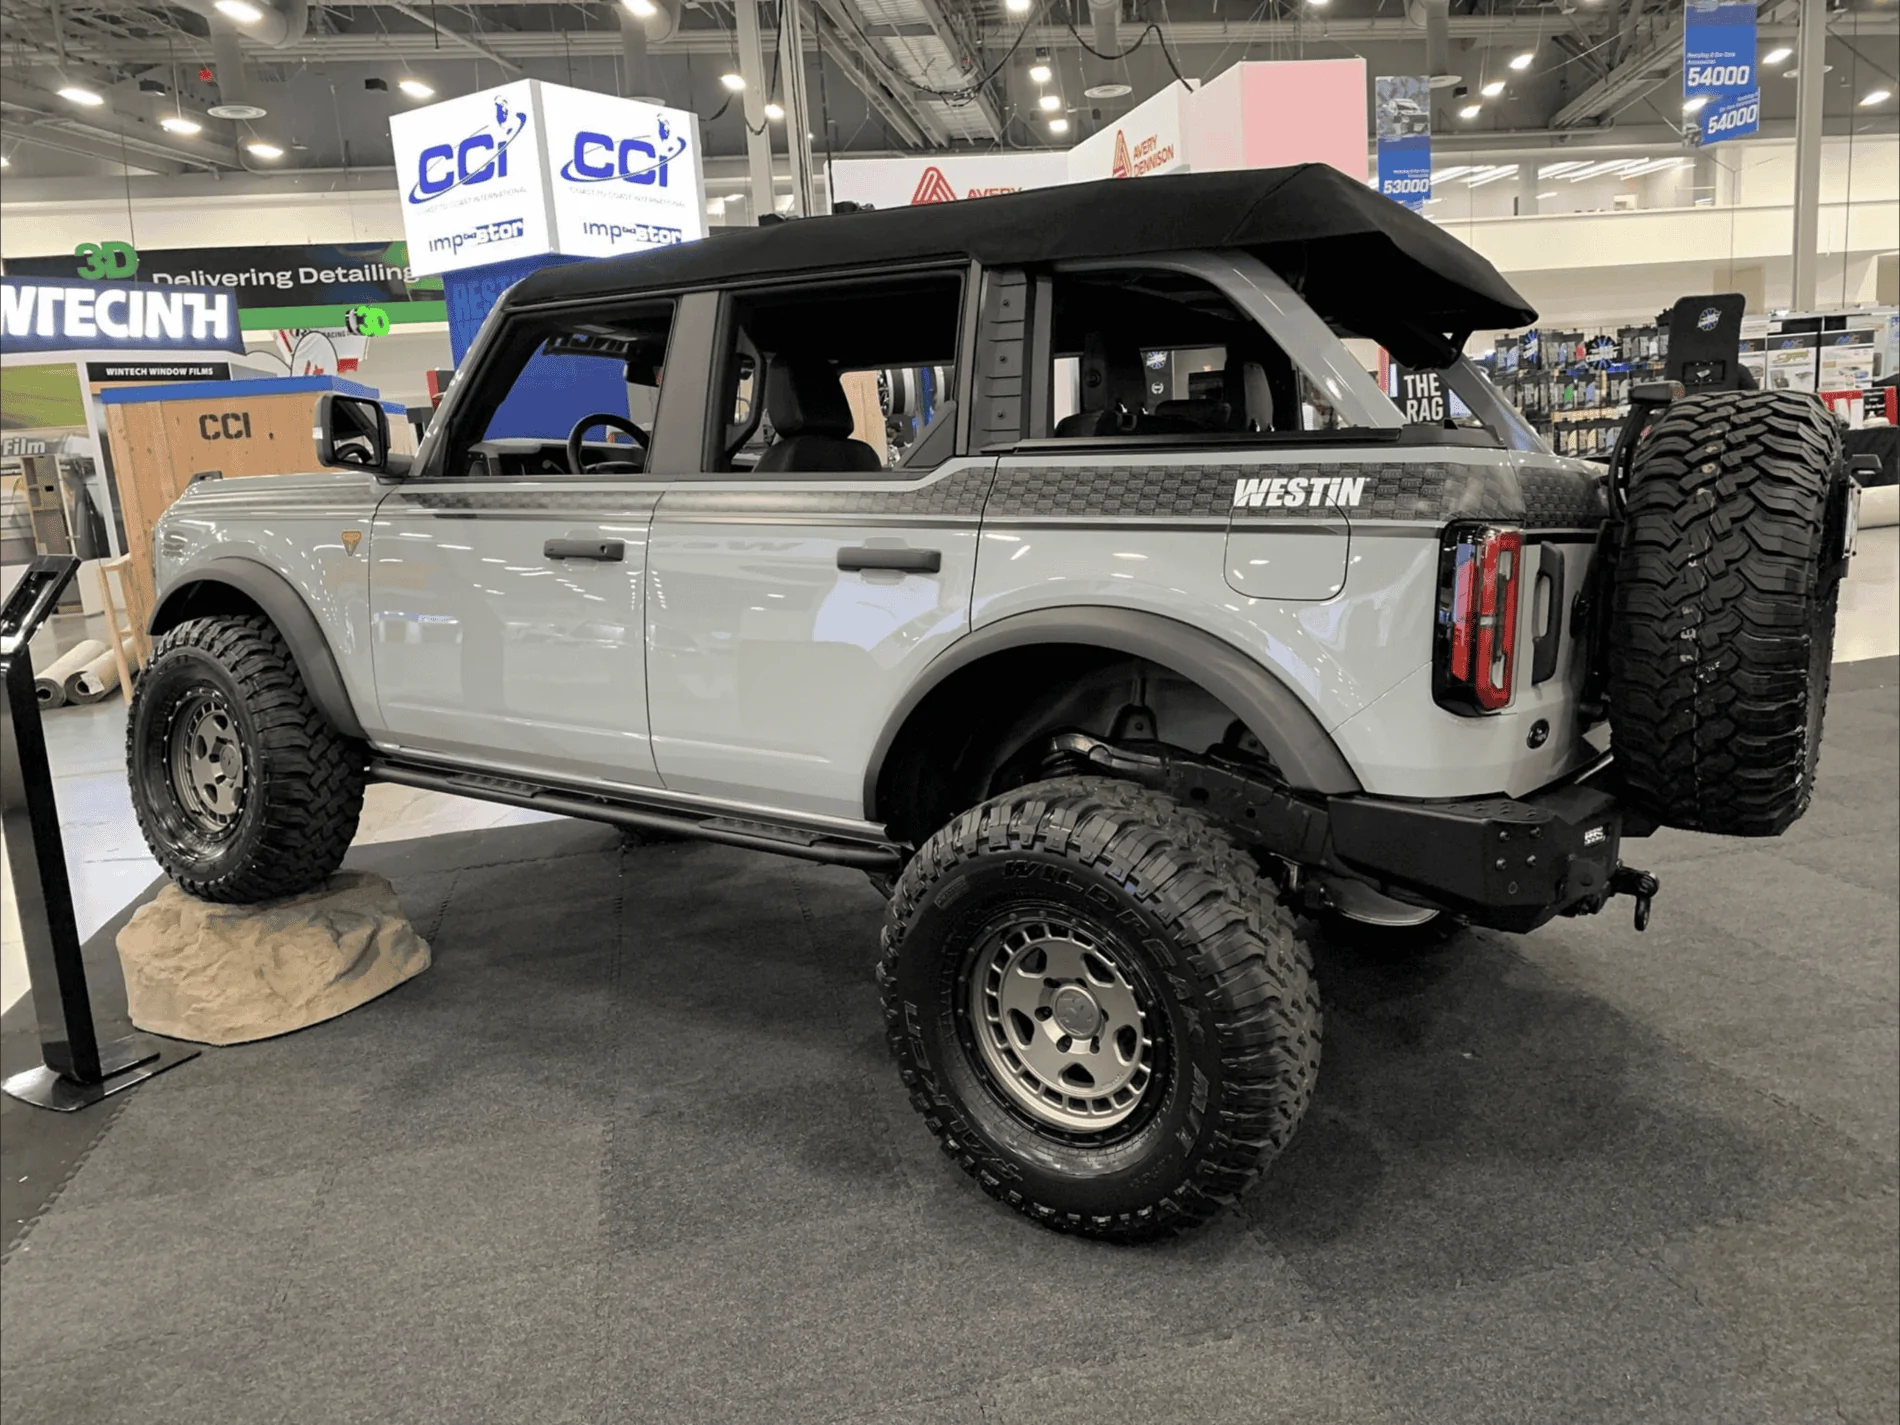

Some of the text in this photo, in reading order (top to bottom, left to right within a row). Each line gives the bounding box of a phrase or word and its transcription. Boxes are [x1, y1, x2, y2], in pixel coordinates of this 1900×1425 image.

[1687, 65, 1750, 87] 54000
[1707, 104, 1758, 134] 54000
[1134, 133, 1158, 160] AVERY
[1383, 179, 1429, 194] 53000
[75, 241, 139, 280] 3D
[152, 264, 420, 290] Delivering Detailing
[105, 367, 214, 376] WINTECH WINDOW FILMS
[1403, 372, 1441, 399] THE
[1406, 397, 1444, 424] RAG
[199, 412, 251, 440] CCI
[2, 438, 46, 456] Film
[1233, 477, 1366, 507] WESTIN
